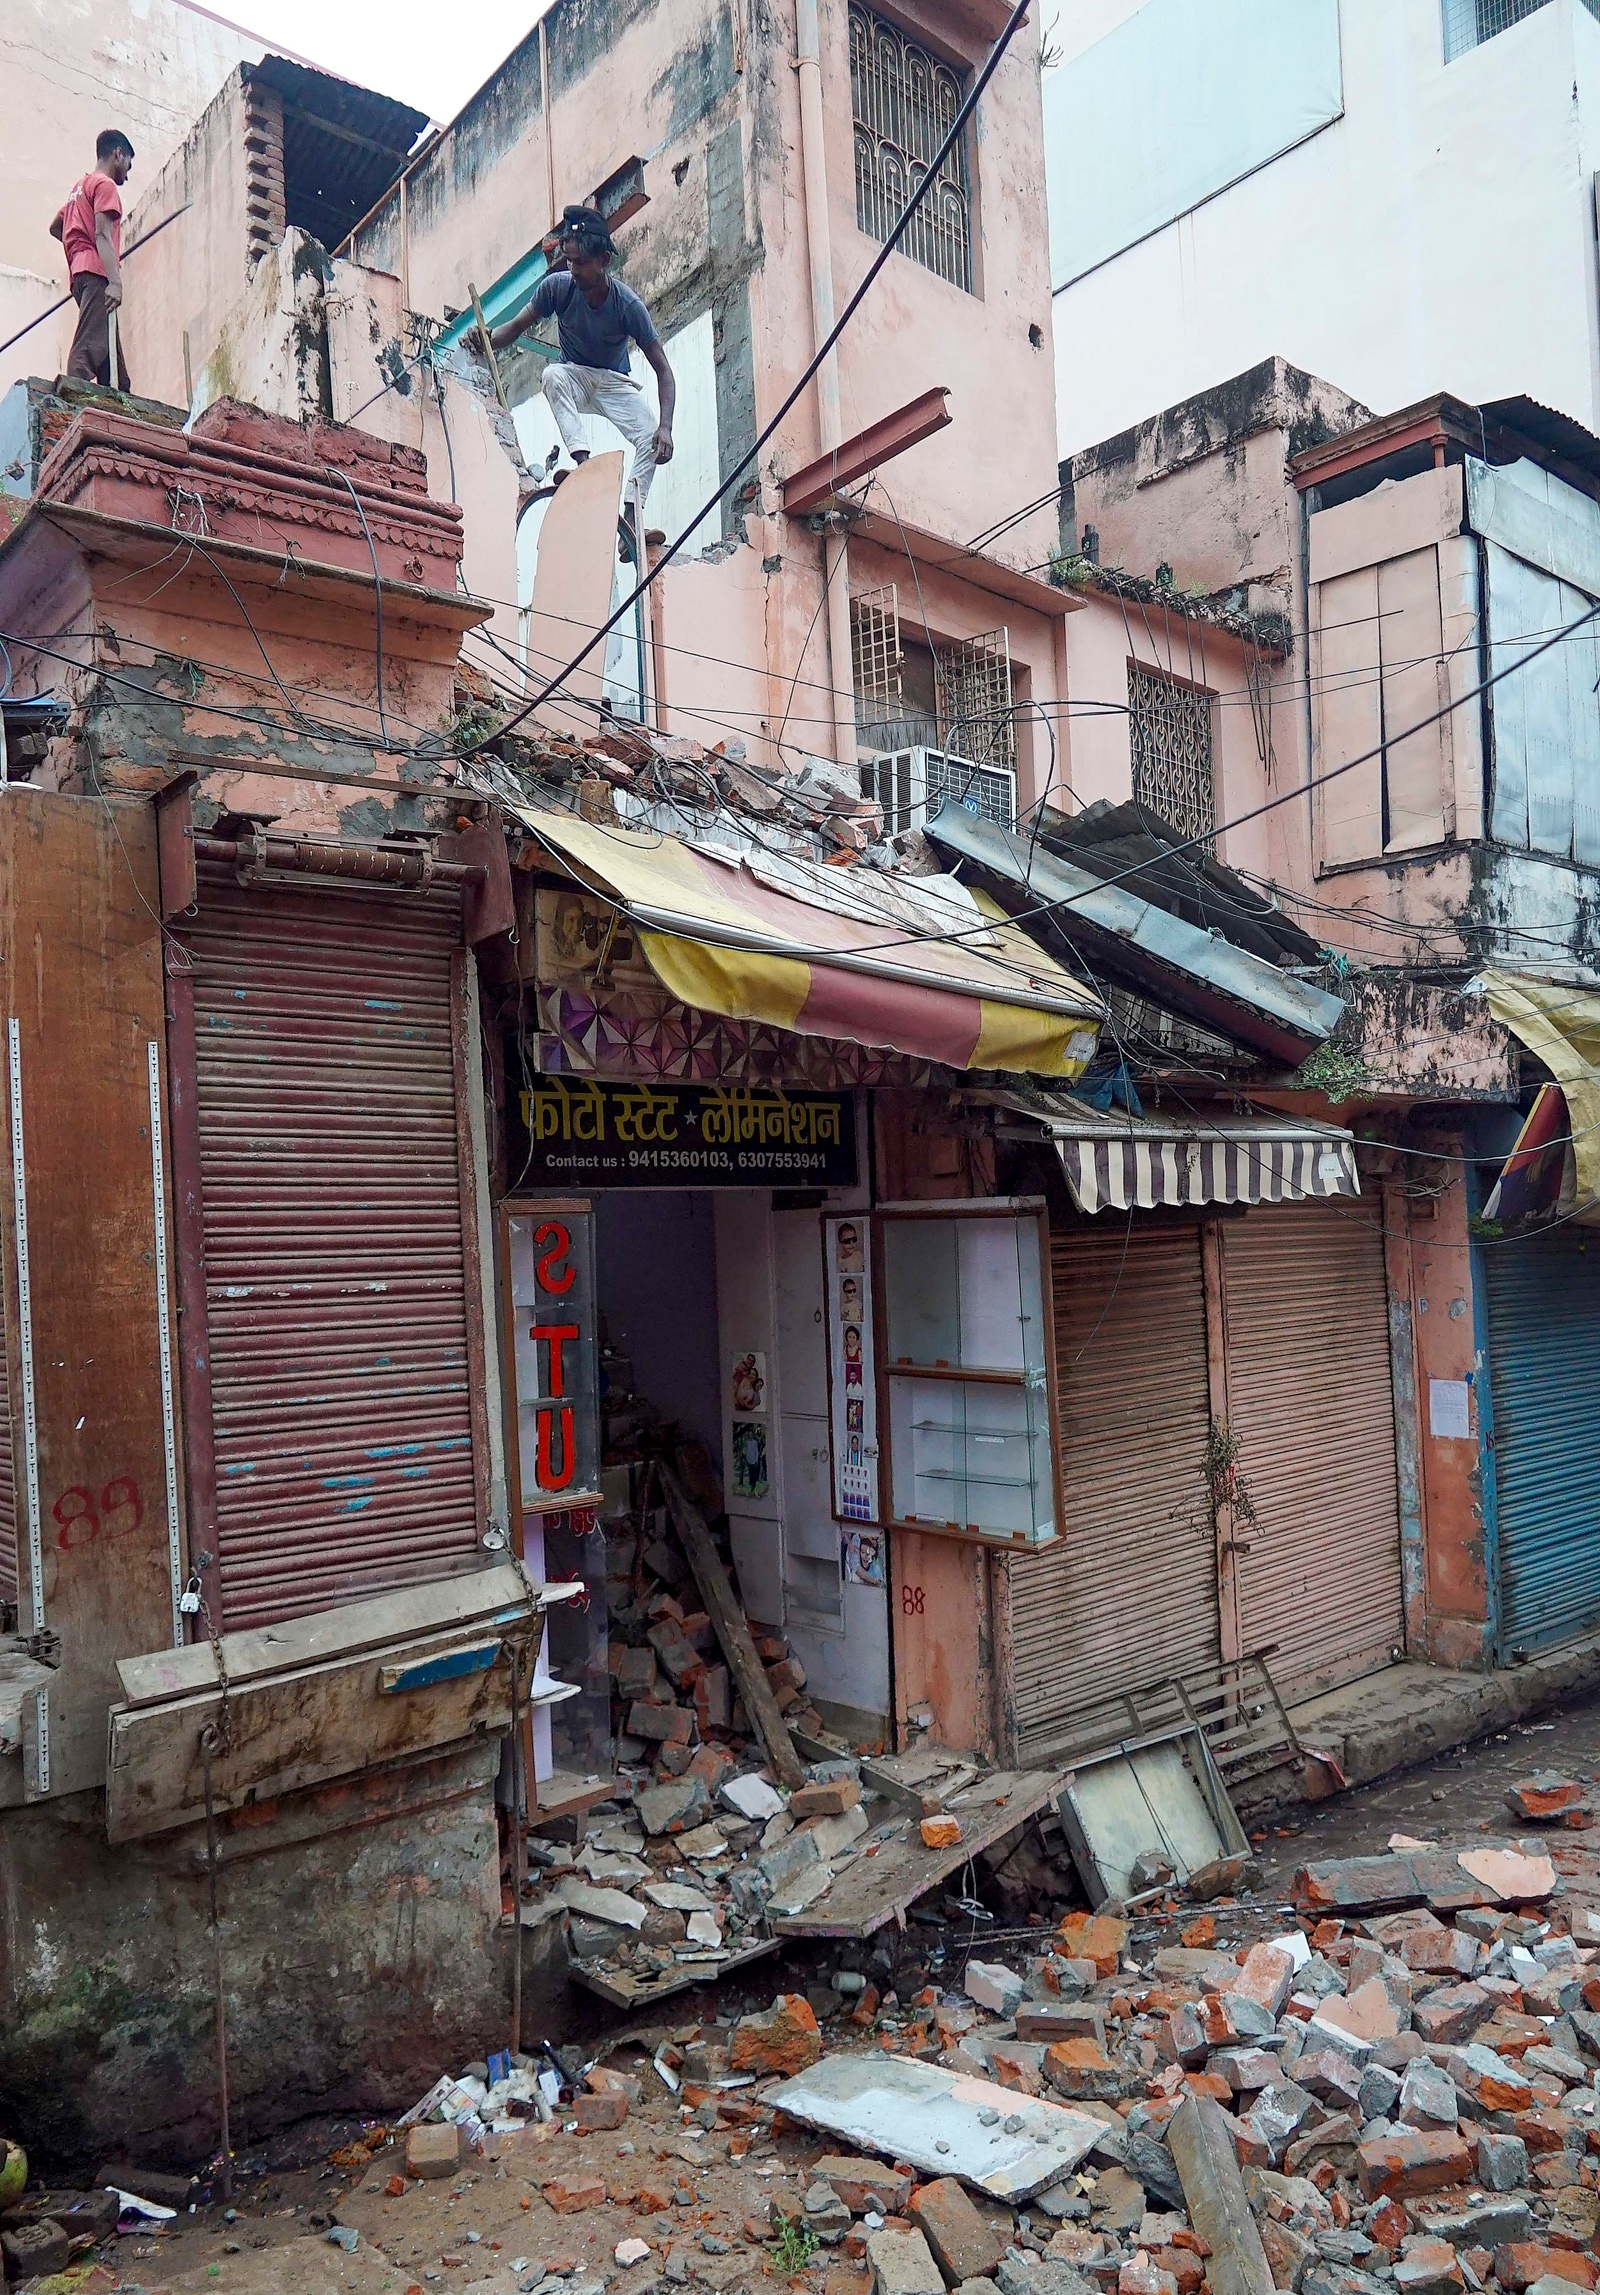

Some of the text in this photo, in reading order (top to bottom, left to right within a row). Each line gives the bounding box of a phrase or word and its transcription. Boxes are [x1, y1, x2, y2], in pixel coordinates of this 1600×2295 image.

[518, 1076, 606, 1140] फोटो
[612, 1082, 679, 1141] स्टेट
[545, 1154, 599, 1167] Contact
[602, 1157, 618, 1167] us
[628, 1150, 734, 1171] 9415360103,
[738, 1152, 827, 1168] 6307553941
[52, 1475, 143, 1551] 89
[902, 1584, 926, 1616] 88
